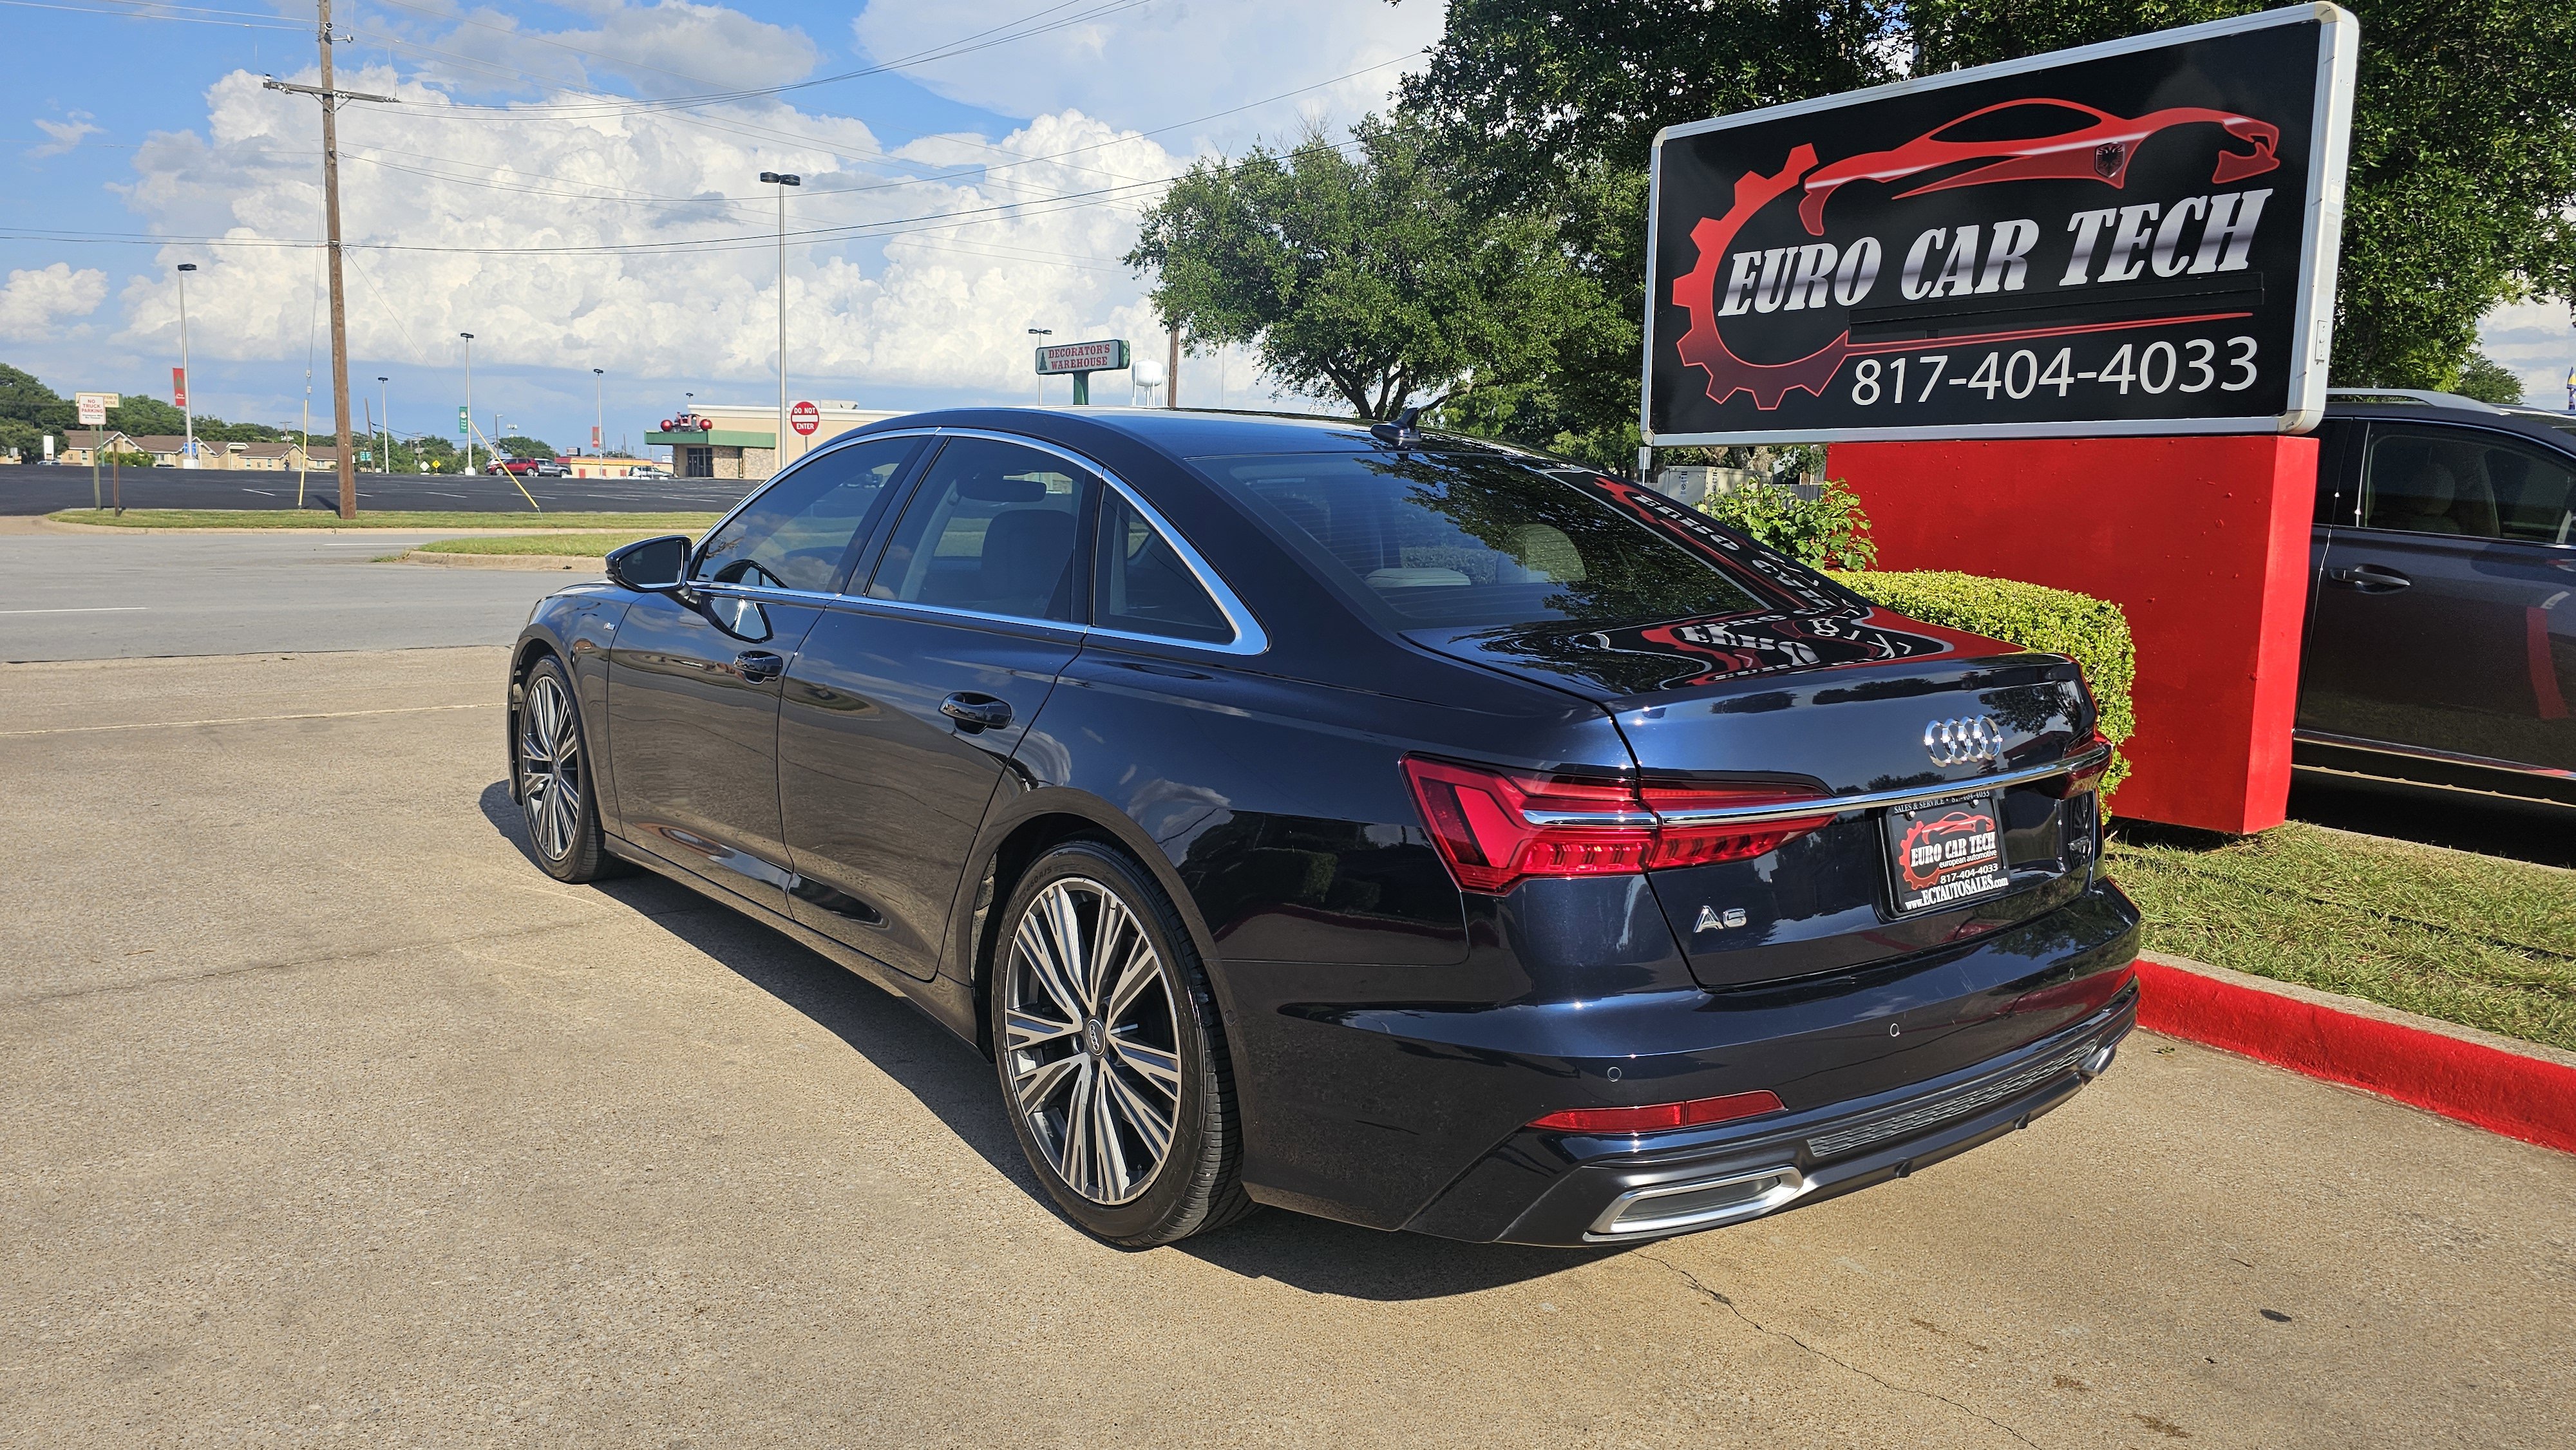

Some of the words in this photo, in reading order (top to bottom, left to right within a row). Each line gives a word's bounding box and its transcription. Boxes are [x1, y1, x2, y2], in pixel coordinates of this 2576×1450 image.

[1718, 236, 1881, 316] EURO
[1900, 218, 2040, 301] CAR
[2059, 188, 2273, 288] TECH
[1048, 344, 1110, 359] DECORATOR'S
[1051, 357, 1107, 370] WAREHOUSE
[1851, 336, 2259, 405] 817-404-4033
[1894, 804, 1912, 813] SALES
[1919, 798, 1944, 809] SERVICE
[1910, 843, 1942, 867] EURO
[1945, 838, 1966, 858] CAR
[1969, 831, 1996, 854] TECH
[1939, 856, 1967, 869] european
[1966, 849, 1997, 863] automotive
[1940, 863, 1998, 884] 817-404-4033
[1905, 874, 2009, 911] www.ECTAUTOSALES.com
[1693, 905, 1747, 933] A6
